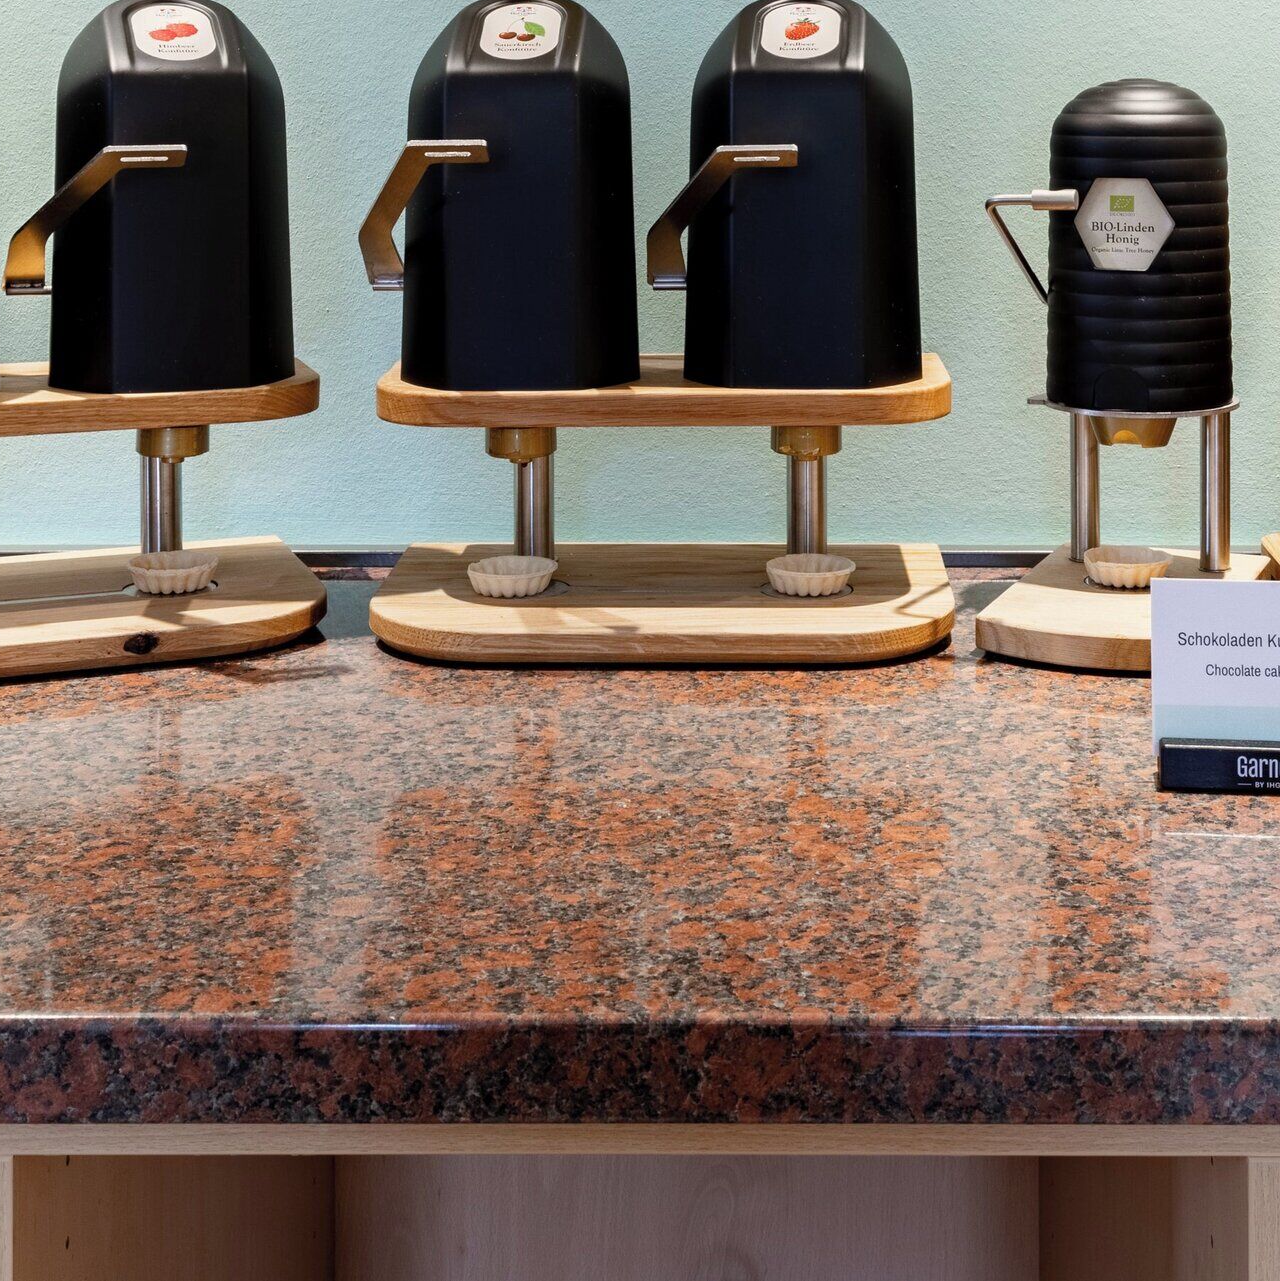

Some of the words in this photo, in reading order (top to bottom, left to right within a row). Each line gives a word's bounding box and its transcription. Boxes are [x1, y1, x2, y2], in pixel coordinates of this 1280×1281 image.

[1106, 234, 1140, 246] Honig
[1177, 632, 1263, 647] Schokoladen
[1205, 664, 1261, 677] Chocolate
